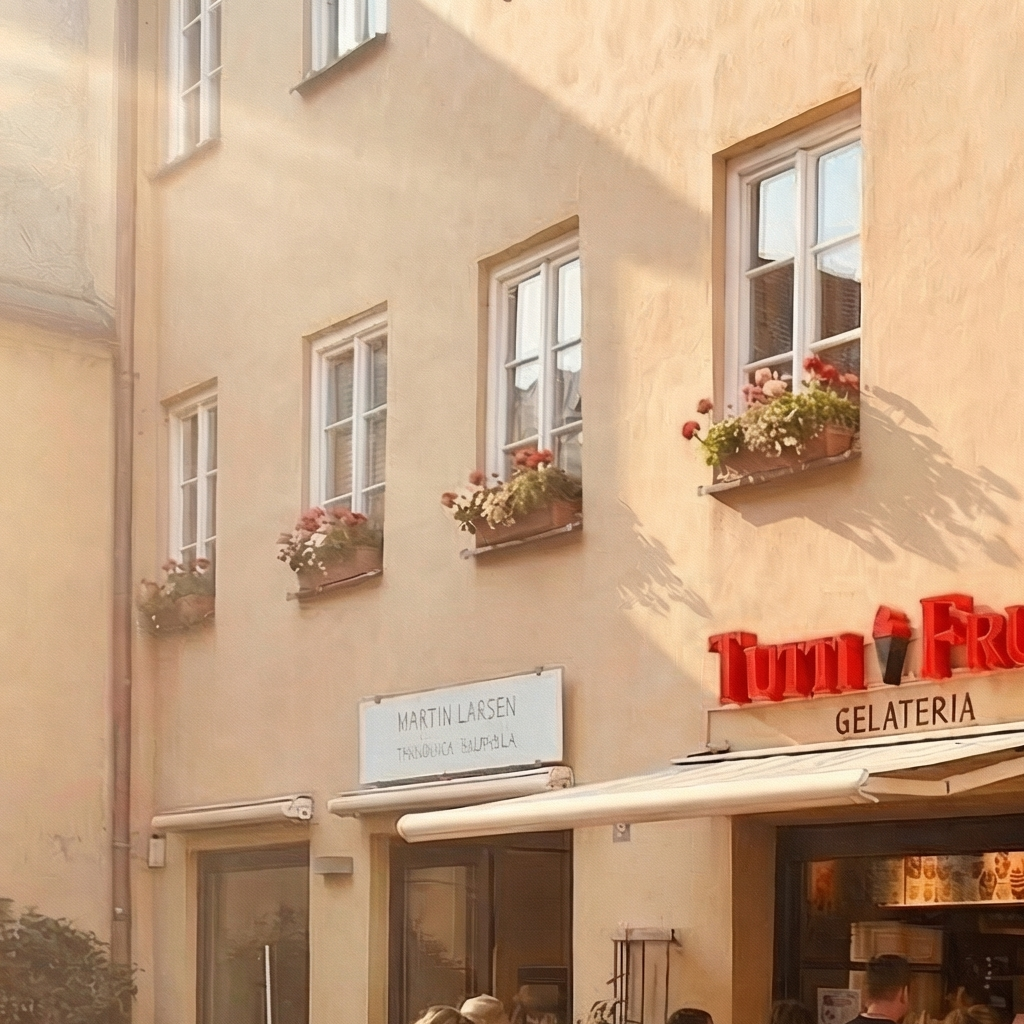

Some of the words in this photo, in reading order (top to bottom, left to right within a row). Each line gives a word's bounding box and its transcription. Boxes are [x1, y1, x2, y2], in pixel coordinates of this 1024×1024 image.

[398, 705, 451, 732] MARTIN
[458, 696, 516, 724] LARSEN
[835, 692, 976, 735] GELATERIA
